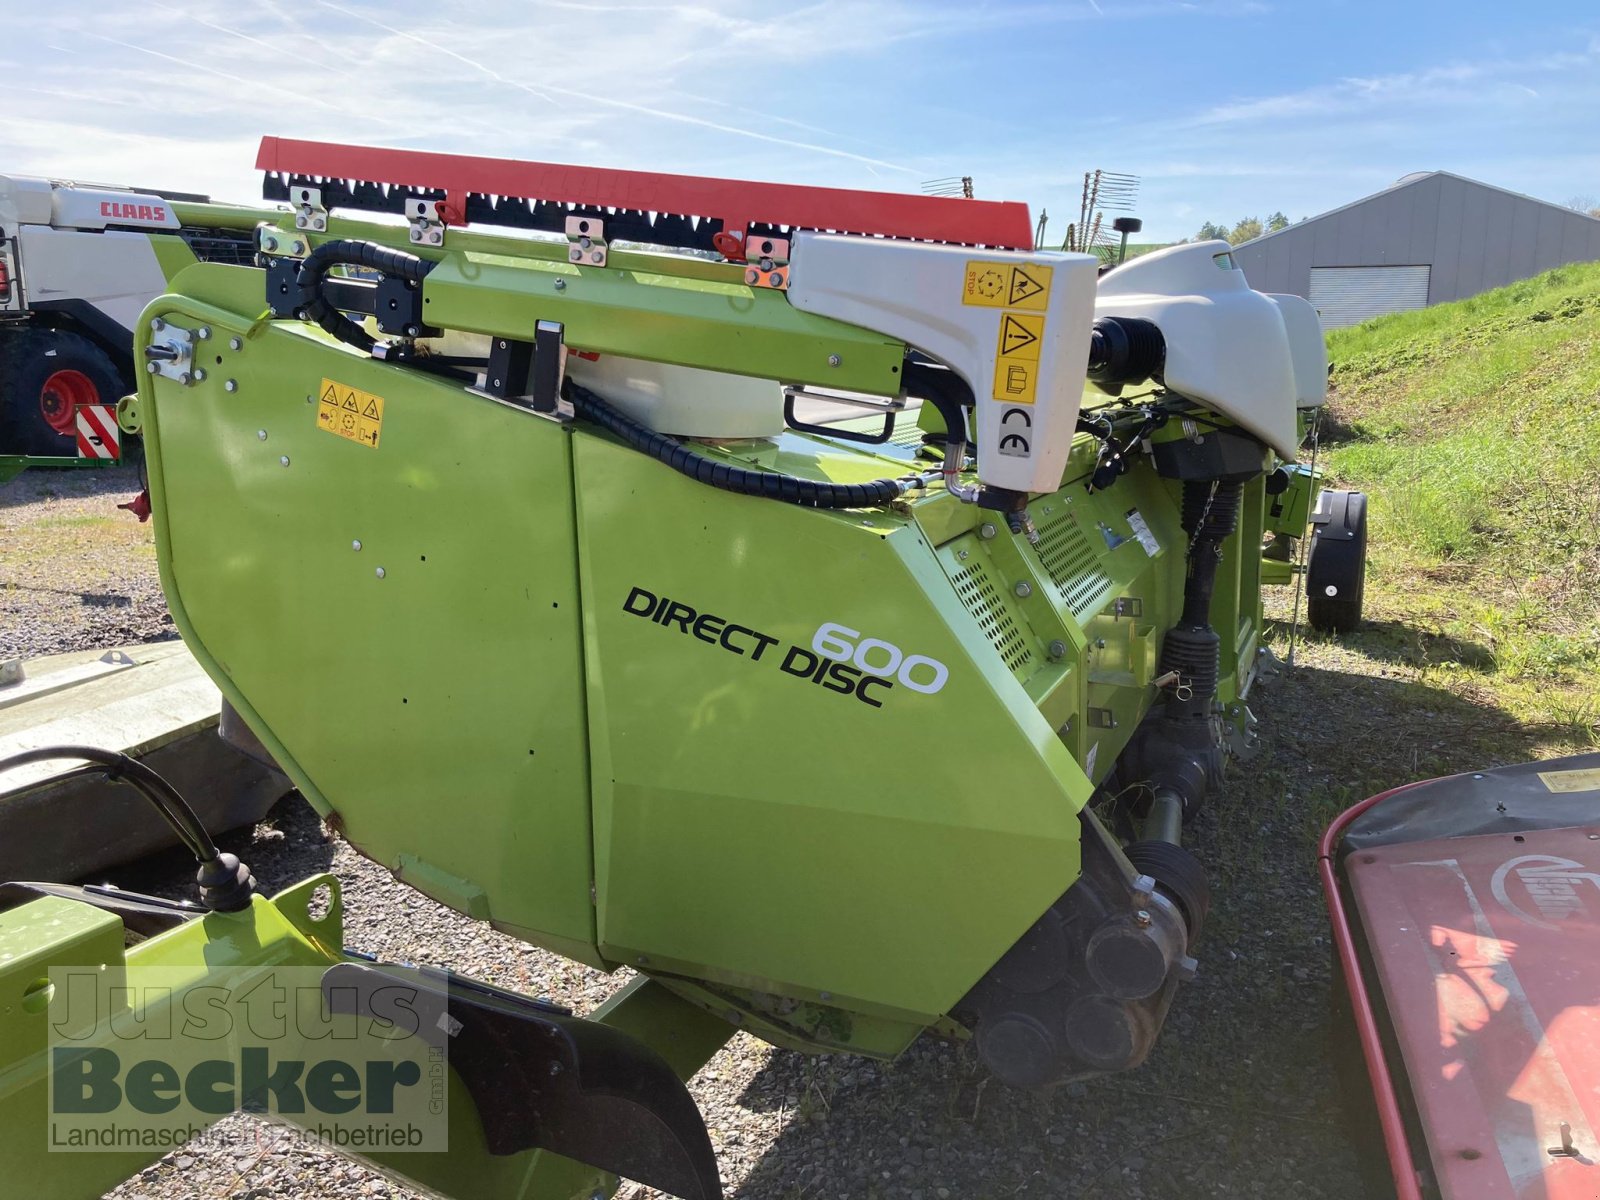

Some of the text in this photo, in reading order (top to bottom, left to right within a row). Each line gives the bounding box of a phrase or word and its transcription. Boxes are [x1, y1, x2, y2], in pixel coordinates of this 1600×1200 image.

[100, 202, 166, 221] CLAAS
[967, 271, 977, 295] STOP
[341, 428, 355, 438] STOP
[1000, 408, 1031, 453] CE
[623, 587, 894, 709] DIRECT DISC
[811, 622, 950, 695] 600
